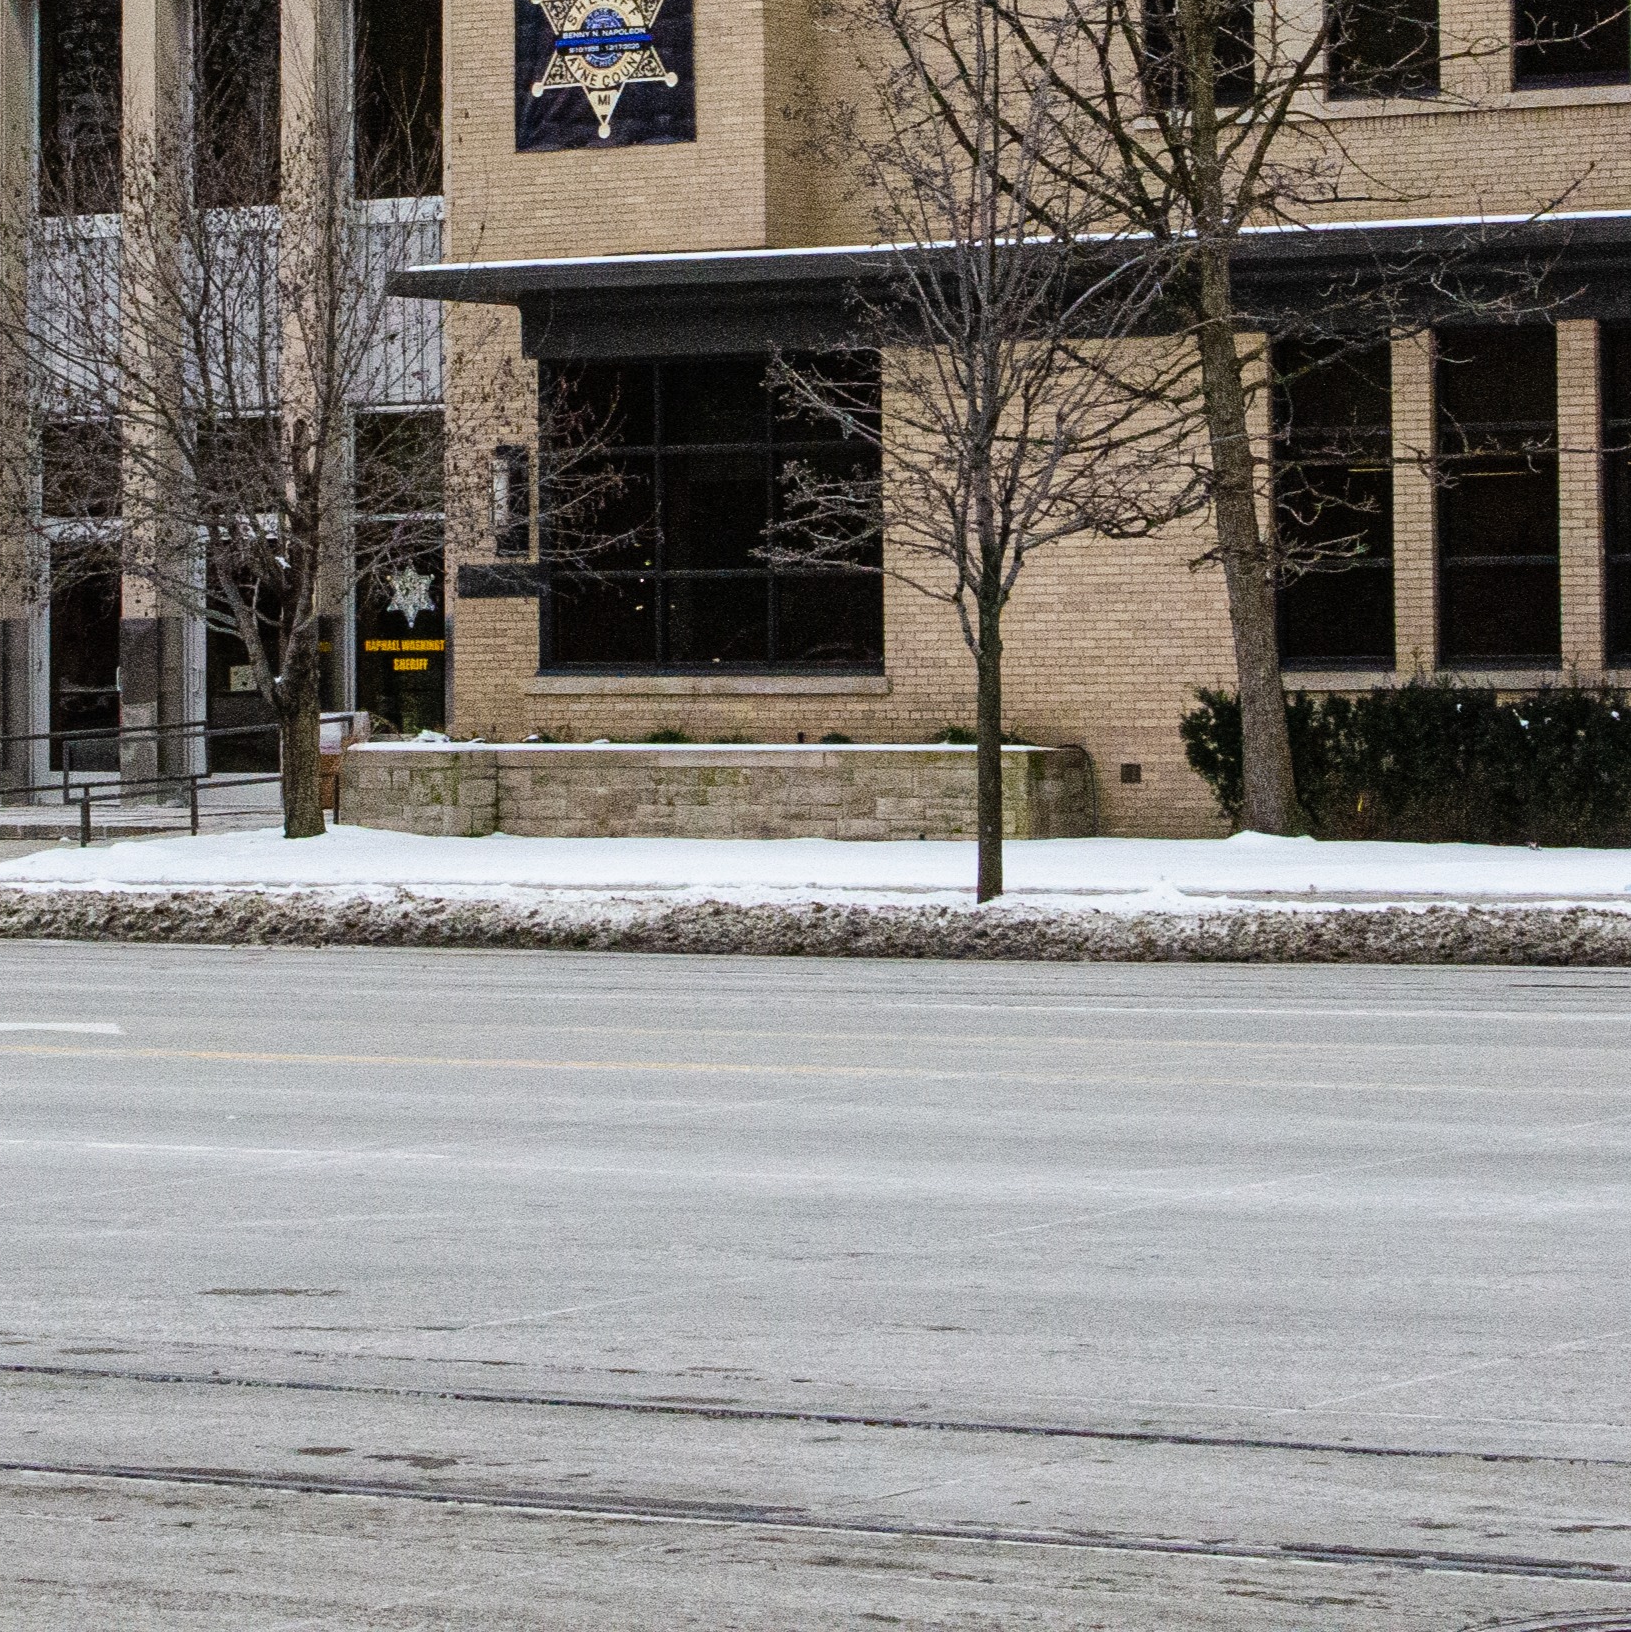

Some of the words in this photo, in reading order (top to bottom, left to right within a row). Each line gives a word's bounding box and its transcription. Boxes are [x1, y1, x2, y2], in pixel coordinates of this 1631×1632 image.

[562, 31, 590, 39] BENNY
[602, 27, 646, 37] NAPOLEON
[597, 94, 611, 106] MI
[393, 658, 429, 671] SHERIFF
